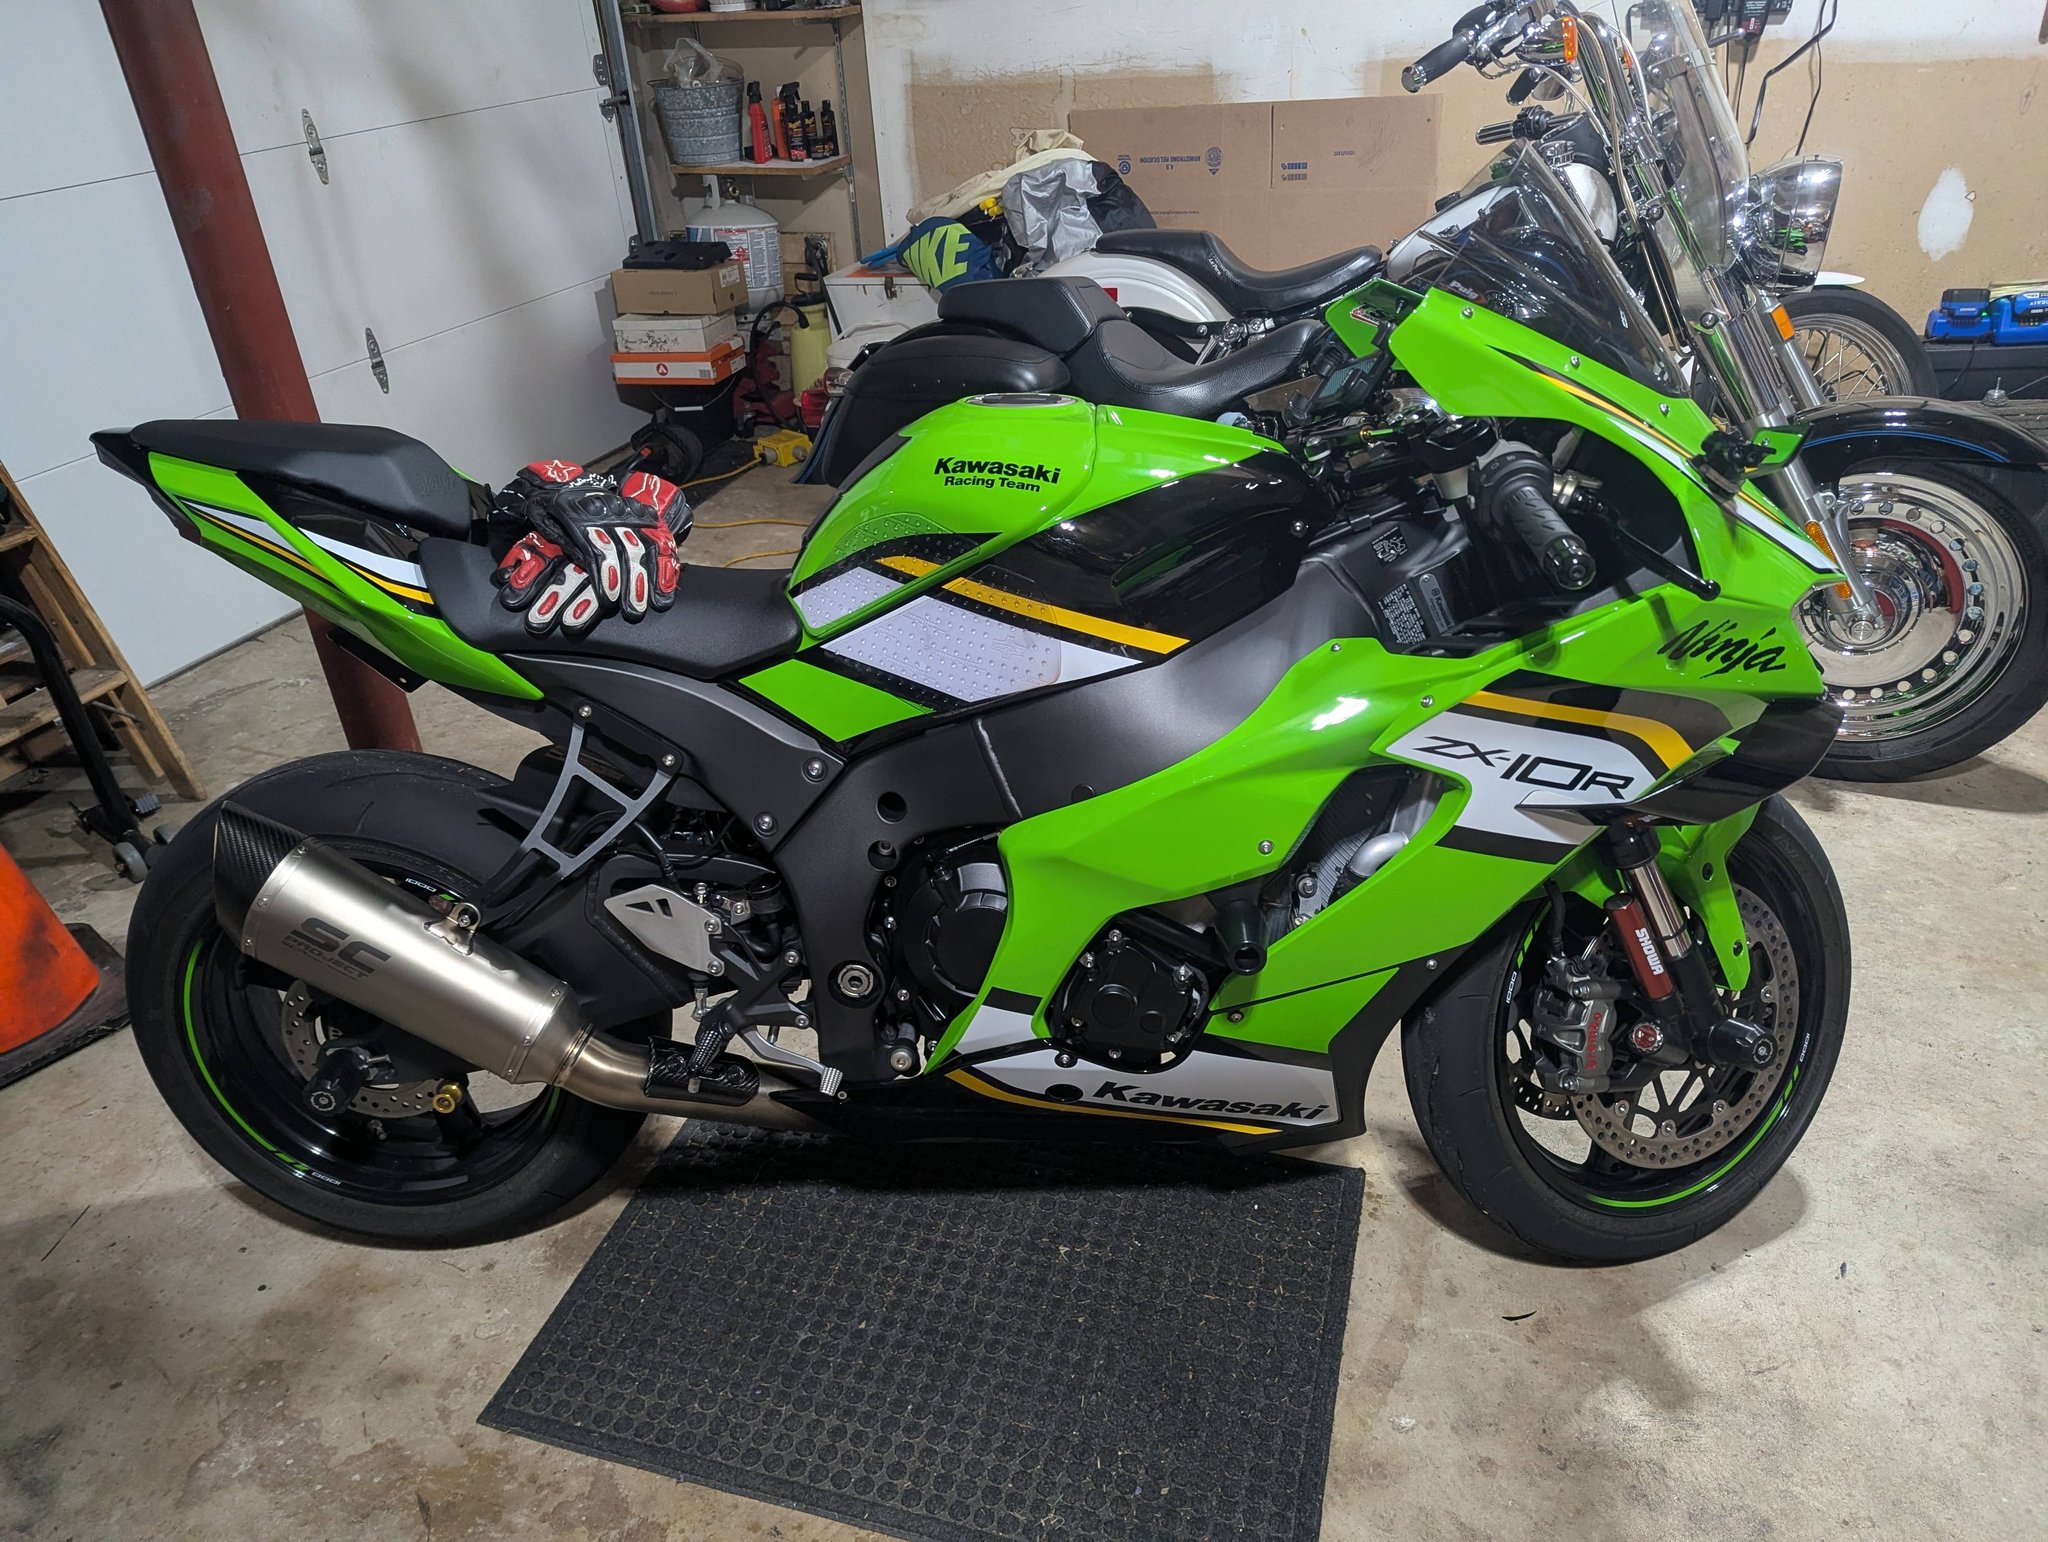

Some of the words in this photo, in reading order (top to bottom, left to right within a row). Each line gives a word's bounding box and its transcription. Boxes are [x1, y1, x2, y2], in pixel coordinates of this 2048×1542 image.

[1449, 280, 1479, 300] Puig
[934, 456, 1062, 484] Kawasaki
[944, 476, 996, 489] Racing
[998, 477, 1041, 492] Team
[1656, 619, 1787, 680] Ninja
[1412, 735, 1635, 800] ZX-10R
[405, 877, 437, 893] 1000
[290, 917, 391, 974] SC
[1634, 927, 1665, 976] SHOWA
[1505, 971, 1518, 1004] 1000
[1799, 1032, 1811, 1063] 1000
[1093, 1080, 1331, 1121] Kawasaki
[311, 1171, 342, 1186] 1000
